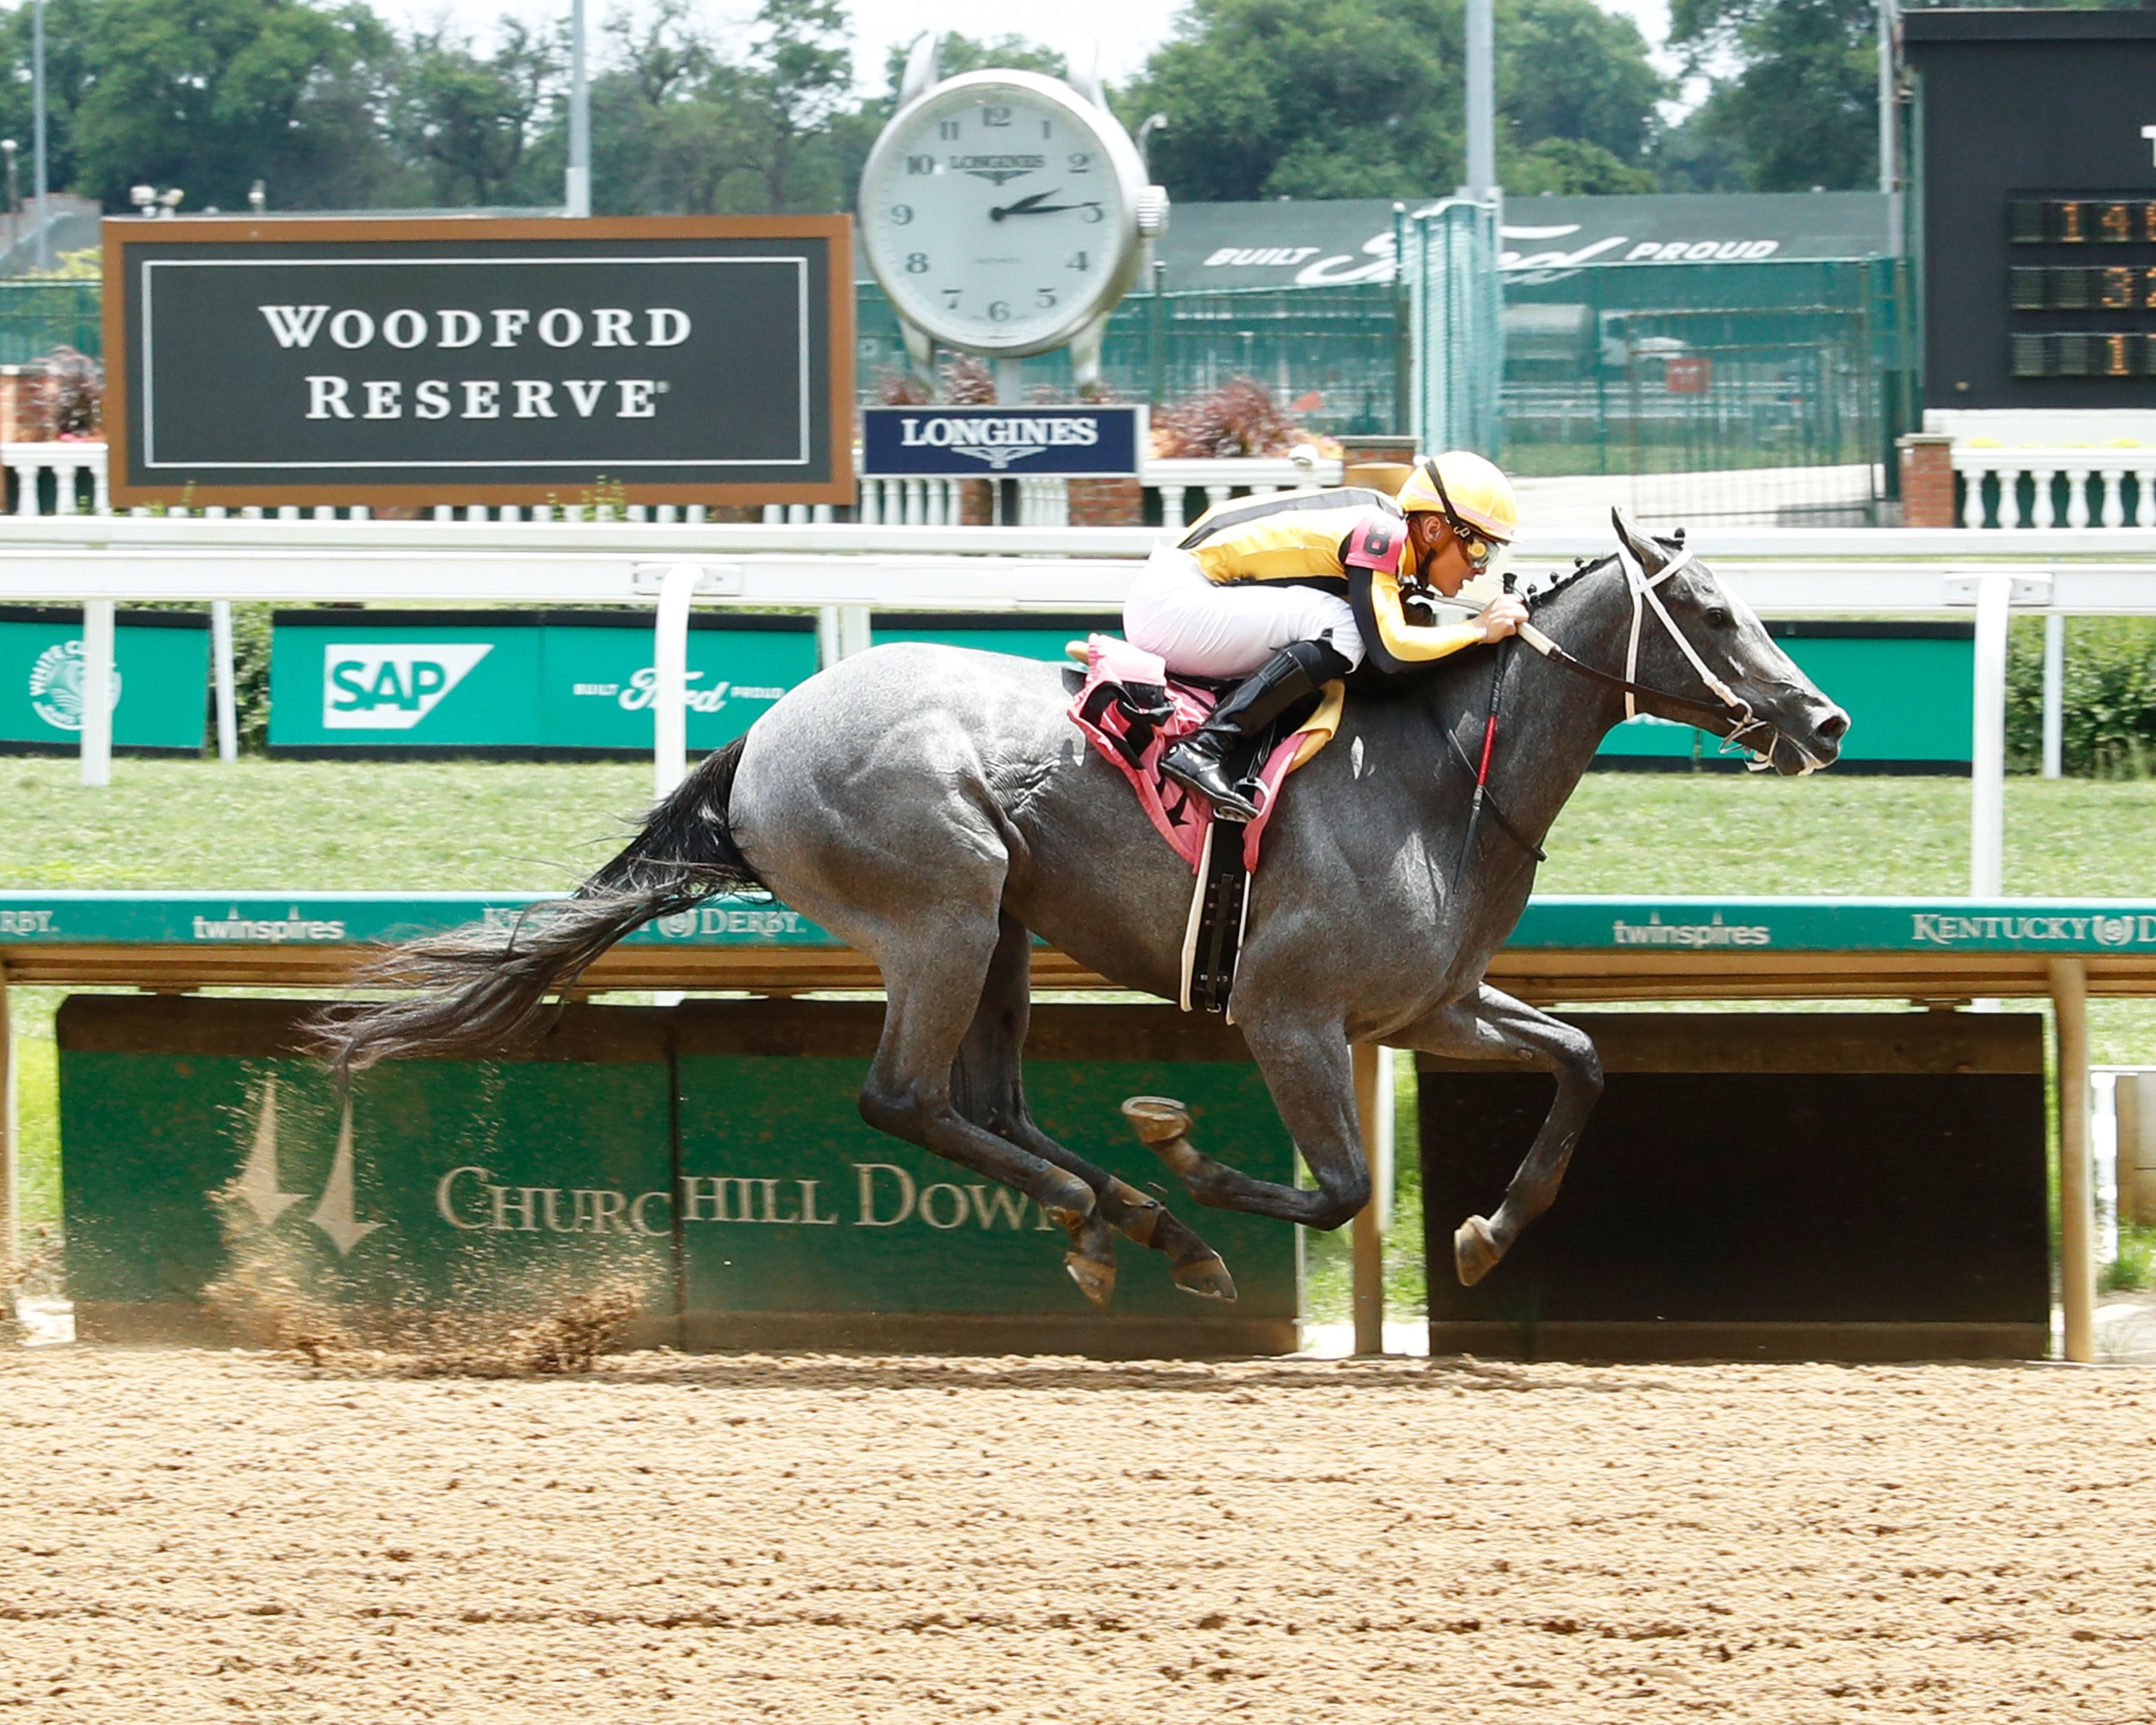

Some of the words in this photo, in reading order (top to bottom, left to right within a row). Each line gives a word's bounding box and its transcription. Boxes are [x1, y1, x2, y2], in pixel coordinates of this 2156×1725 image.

[983, 107, 1012, 128] 12
[940, 120, 959, 141] 11
[1043, 120, 1052, 140] 1
[907, 155, 933, 175] 10
[949, 155, 1046, 169] LONGINES
[1068, 152, 1089, 173] 2
[891, 204, 915, 225] 9
[906, 253, 929, 274] 8
[1065, 251, 1089, 271] 4
[1203, 247, 1320, 266] BUILT
[1625, 240, 1779, 261] PROUD
[940, 289, 964, 310] 7
[1035, 287, 1056, 308] 5
[989, 301, 1010, 322] 6
[259, 305, 691, 349] WOODFORD
[900, 418, 1098, 446] LONGINES
[1363, 521, 1394, 556] 8
[332, 660, 446, 712] SAP
[191, 904, 346, 943] twinspires
[1612, 910, 1771, 948] twinspires
[1911, 913, 2090, 945] KENTUCKY
[435, 1166, 837, 1237] CHURCHILL
